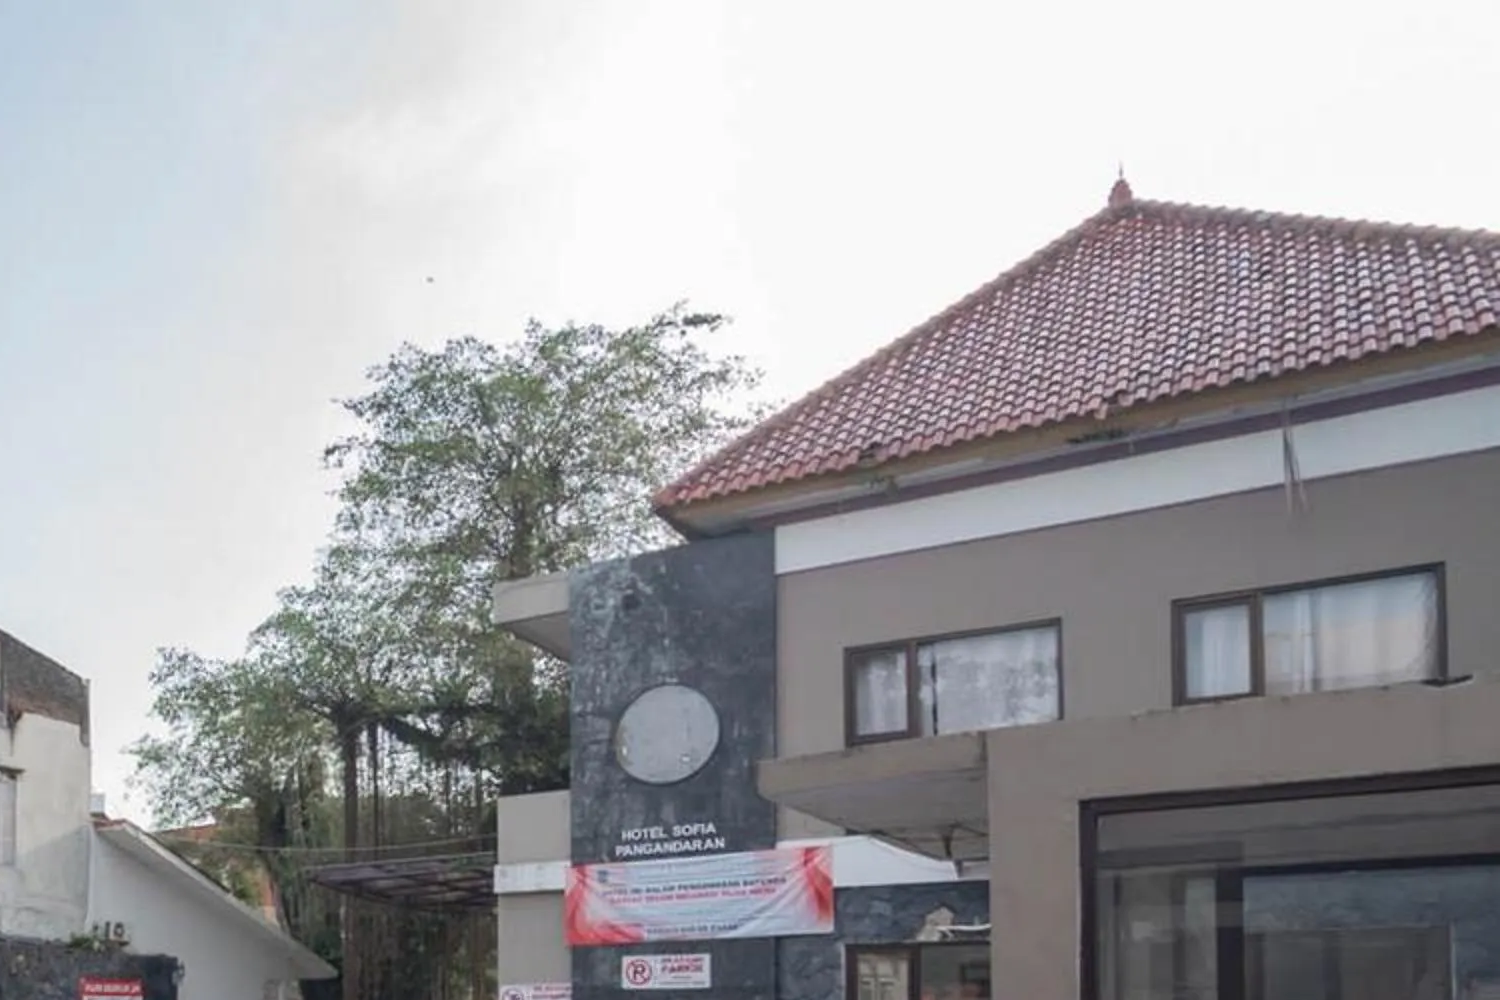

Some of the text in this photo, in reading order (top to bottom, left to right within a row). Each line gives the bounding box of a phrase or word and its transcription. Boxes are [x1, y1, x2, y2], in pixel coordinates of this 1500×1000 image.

[621, 822, 716, 841] HOTEL SOFIA
[614, 836, 725, 856] PANGANDARAN
